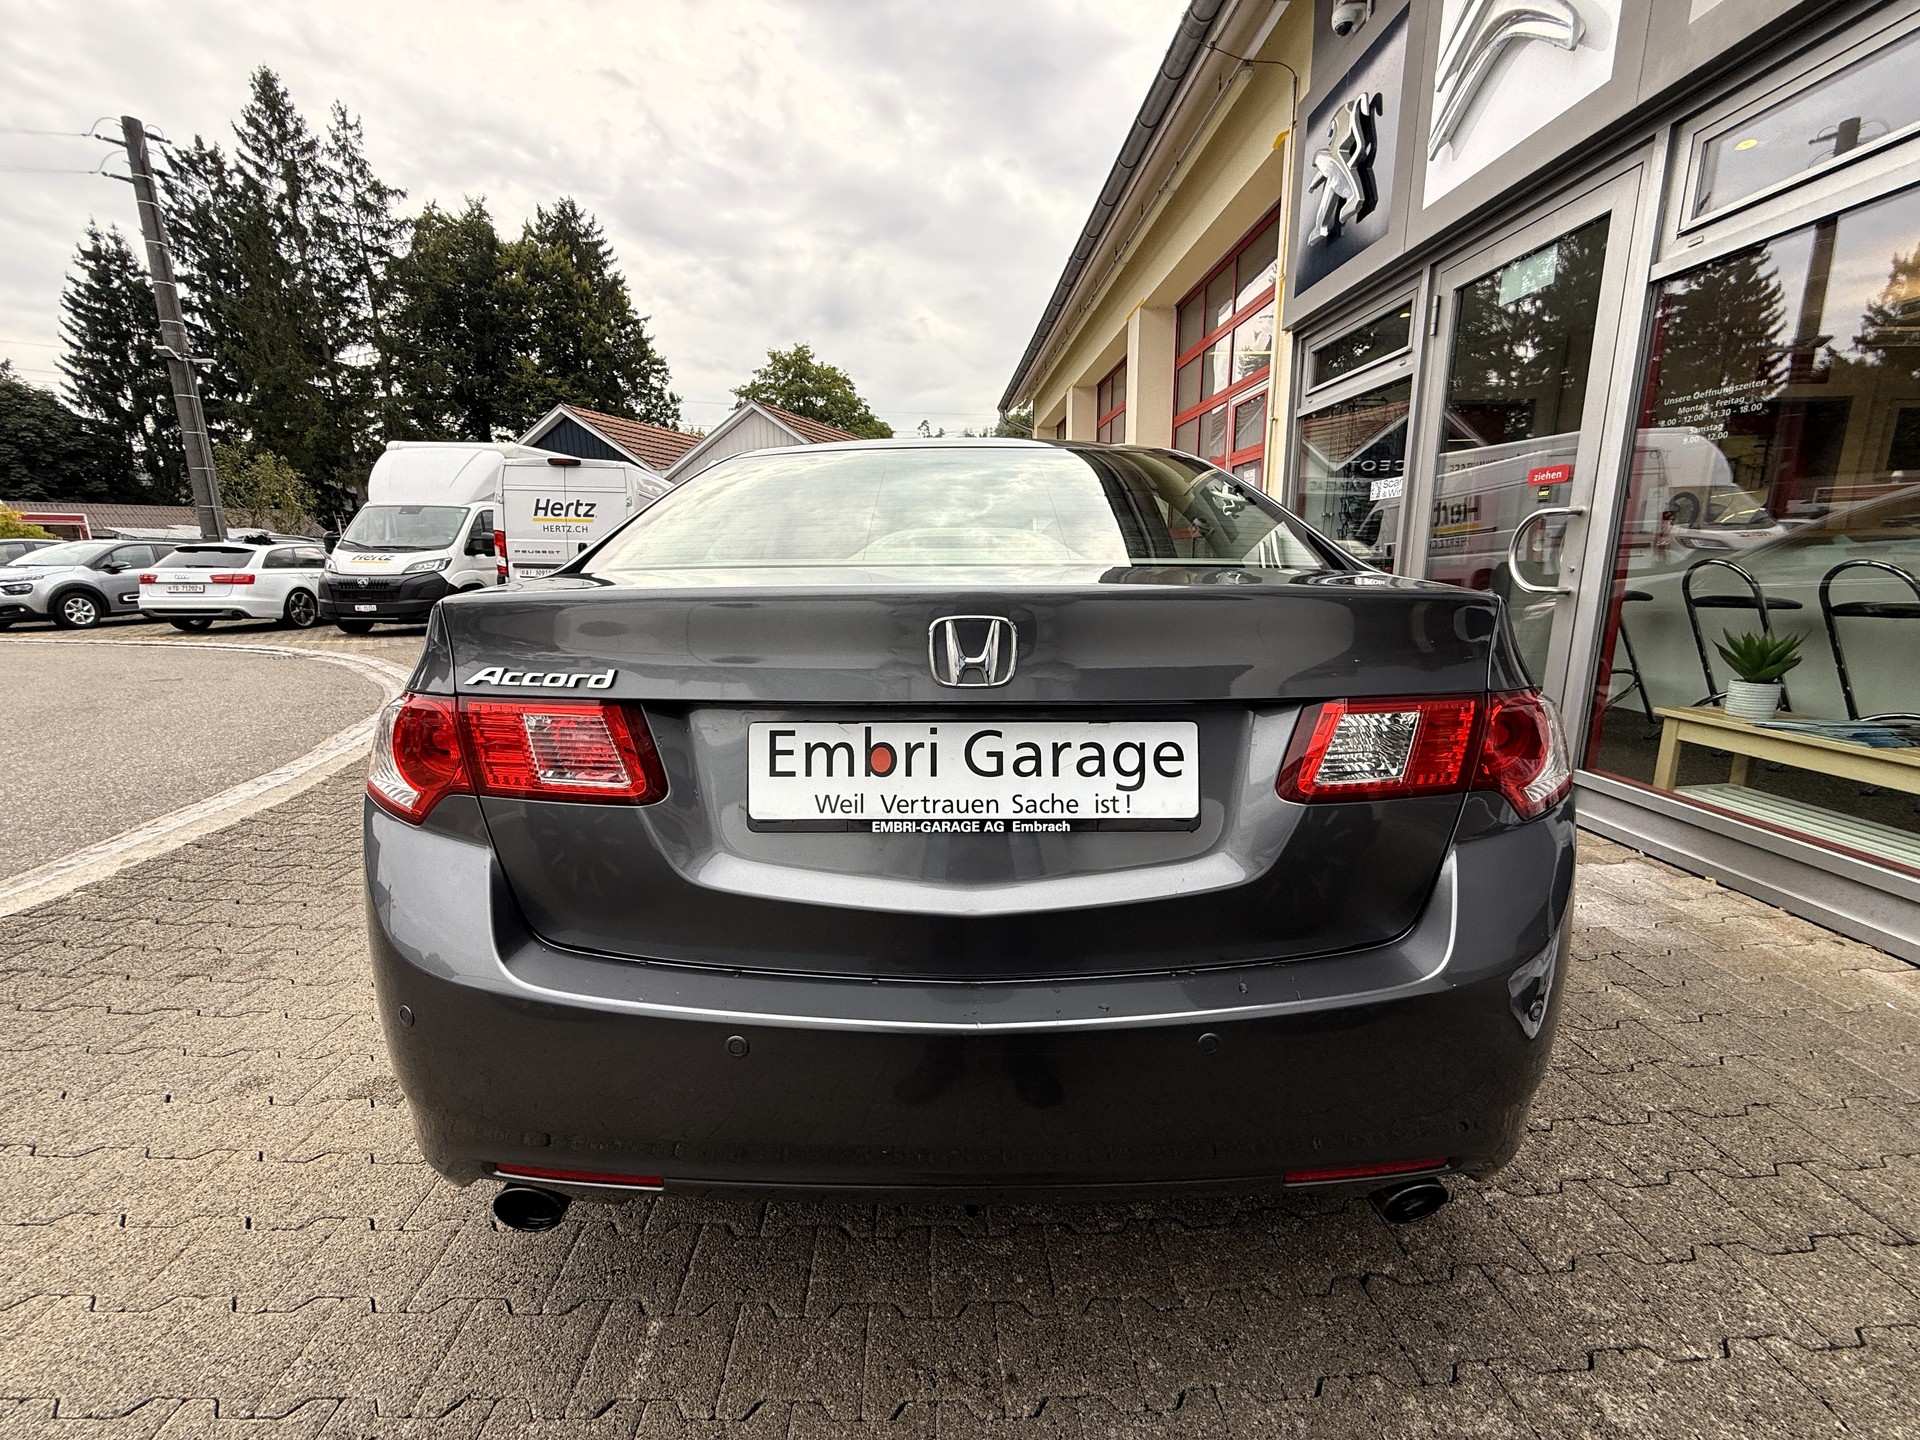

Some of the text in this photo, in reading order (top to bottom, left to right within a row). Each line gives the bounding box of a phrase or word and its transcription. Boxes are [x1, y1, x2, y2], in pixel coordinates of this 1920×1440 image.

[1664, 379, 1768, 405] Unsere Oeffnungszeiten
[1660, 418, 1677, 427] 8.00
[1683, 413, 1704, 422] 12.00
[1710, 409, 1731, 419] 13.30
[1739, 402, 1763, 413] 18.00
[1677, 403, 1708, 414] Montag
[1715, 396, 1745, 407] Freitag
[1682, 436, 1700, 445] 9.00
[1707, 431, 1729, 440] 12.00
[1689, 423, 1724, 434] Samstag
[1533, 469, 1562, 481] ziehen
[533, 498, 597, 518] Hertz
[543, 525, 588, 533] HERTZ.CH
[464, 667, 617, 689] Accord
[769, 726, 1184, 791] Embri Garage
[815, 793, 864, 814] Weil
[880, 794, 999, 814] Vertrauen
[1012, 793, 1079, 814] Sache
[872, 820, 1071, 833] EMBRI-GARAGE AG Embrach
